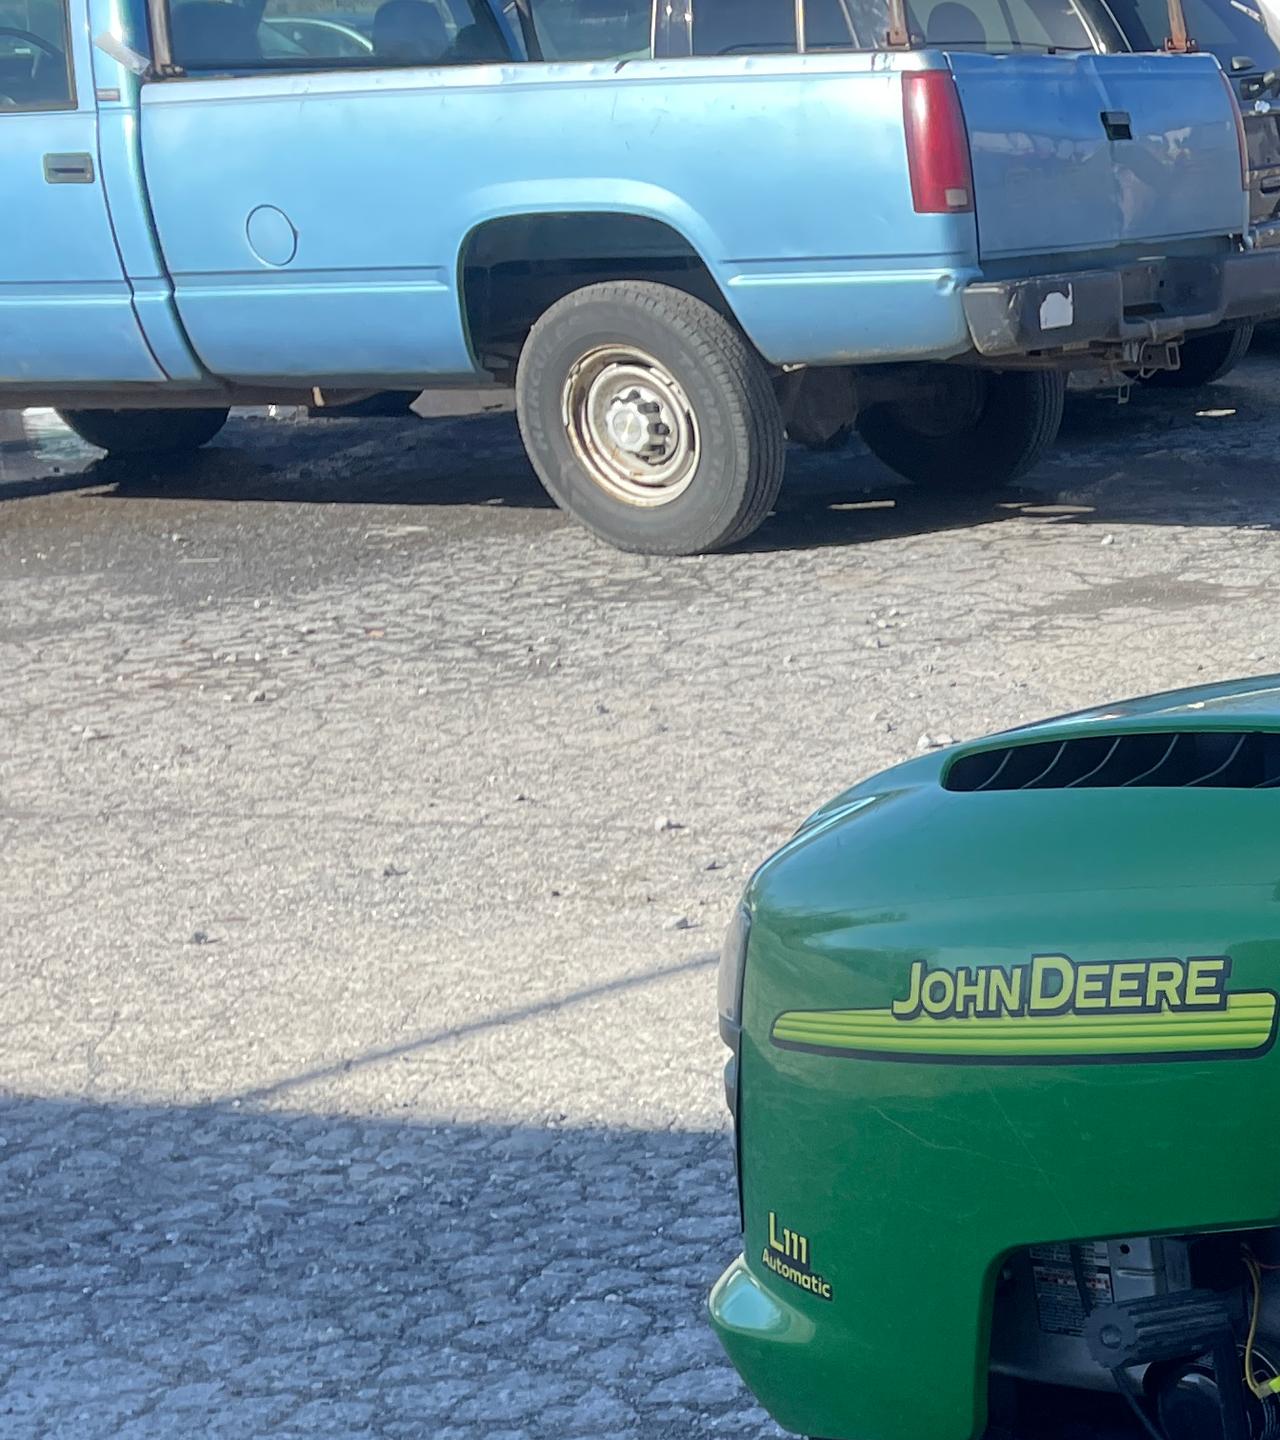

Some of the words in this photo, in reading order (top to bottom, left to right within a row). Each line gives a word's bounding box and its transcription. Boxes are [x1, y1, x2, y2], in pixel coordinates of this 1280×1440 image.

[892, 960, 1024, 1017] JOHN
[1027, 955, 1227, 1013] DEERE
[769, 1211, 807, 1264] L111
[762, 1247, 831, 1298] Automatic
